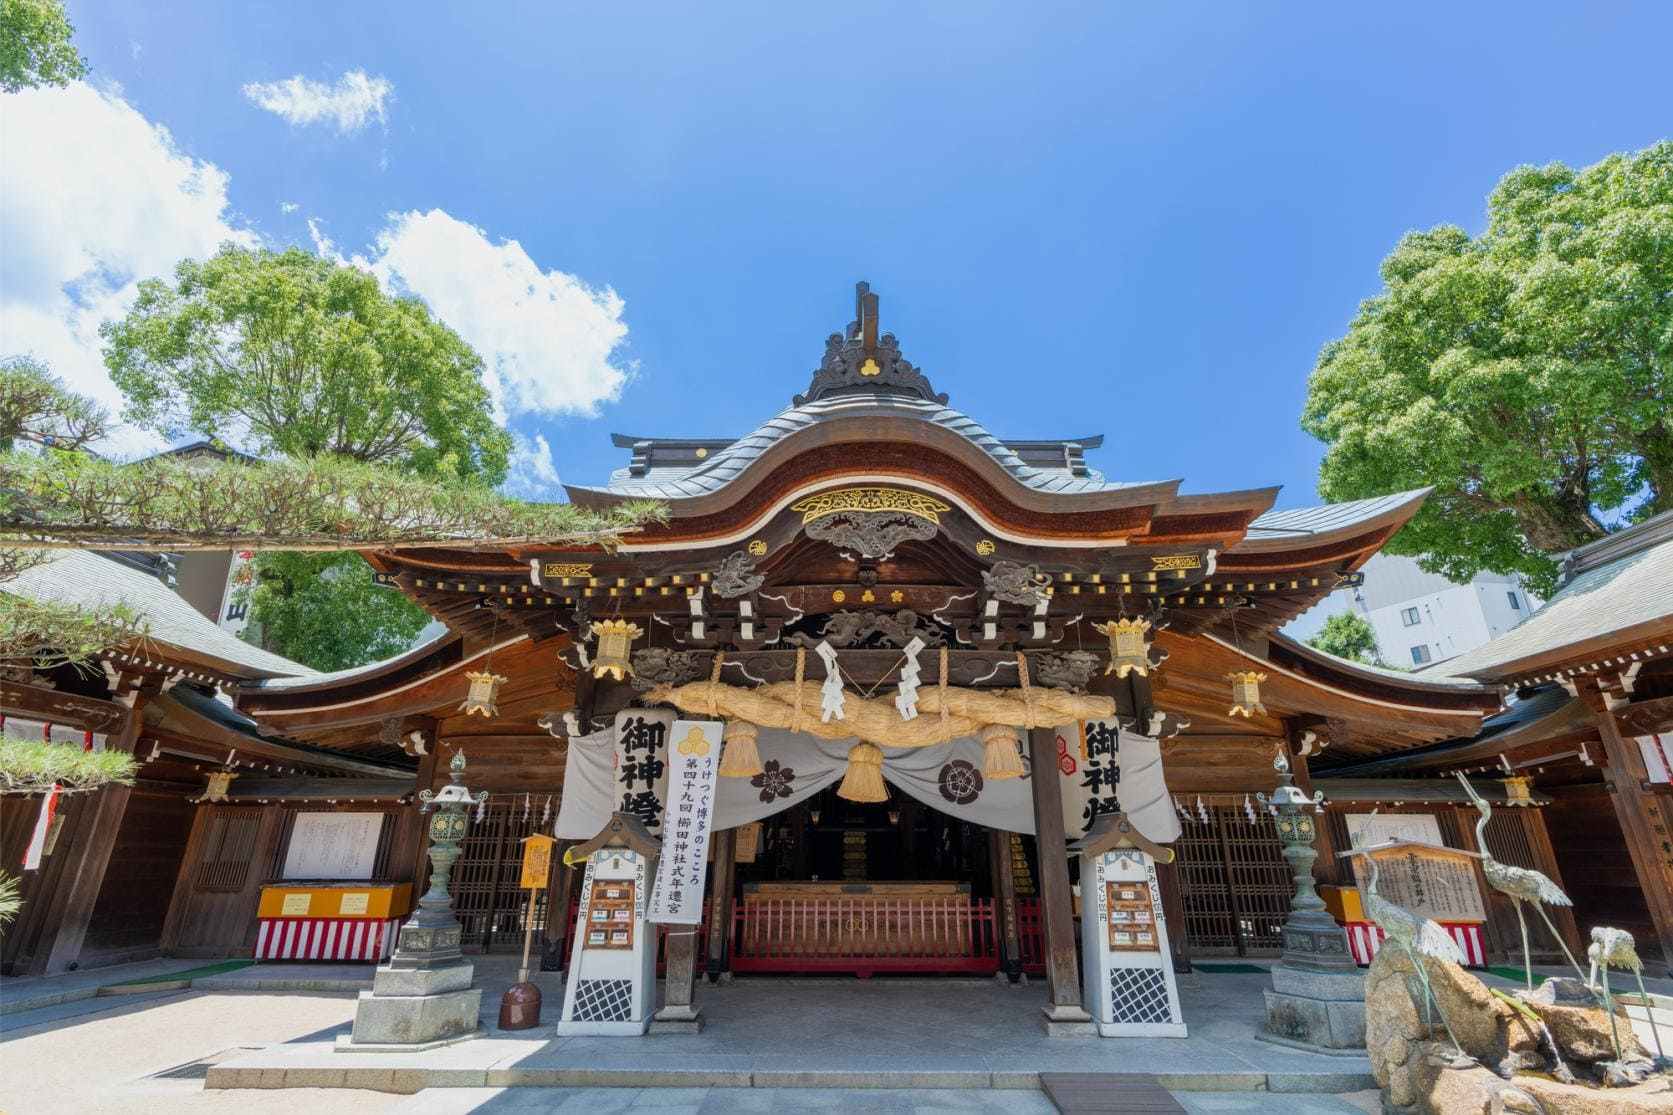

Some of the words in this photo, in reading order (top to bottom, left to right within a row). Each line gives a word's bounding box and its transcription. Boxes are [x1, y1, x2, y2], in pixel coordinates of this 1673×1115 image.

[690, 757, 713, 886] うけつぐ博多のこころ
